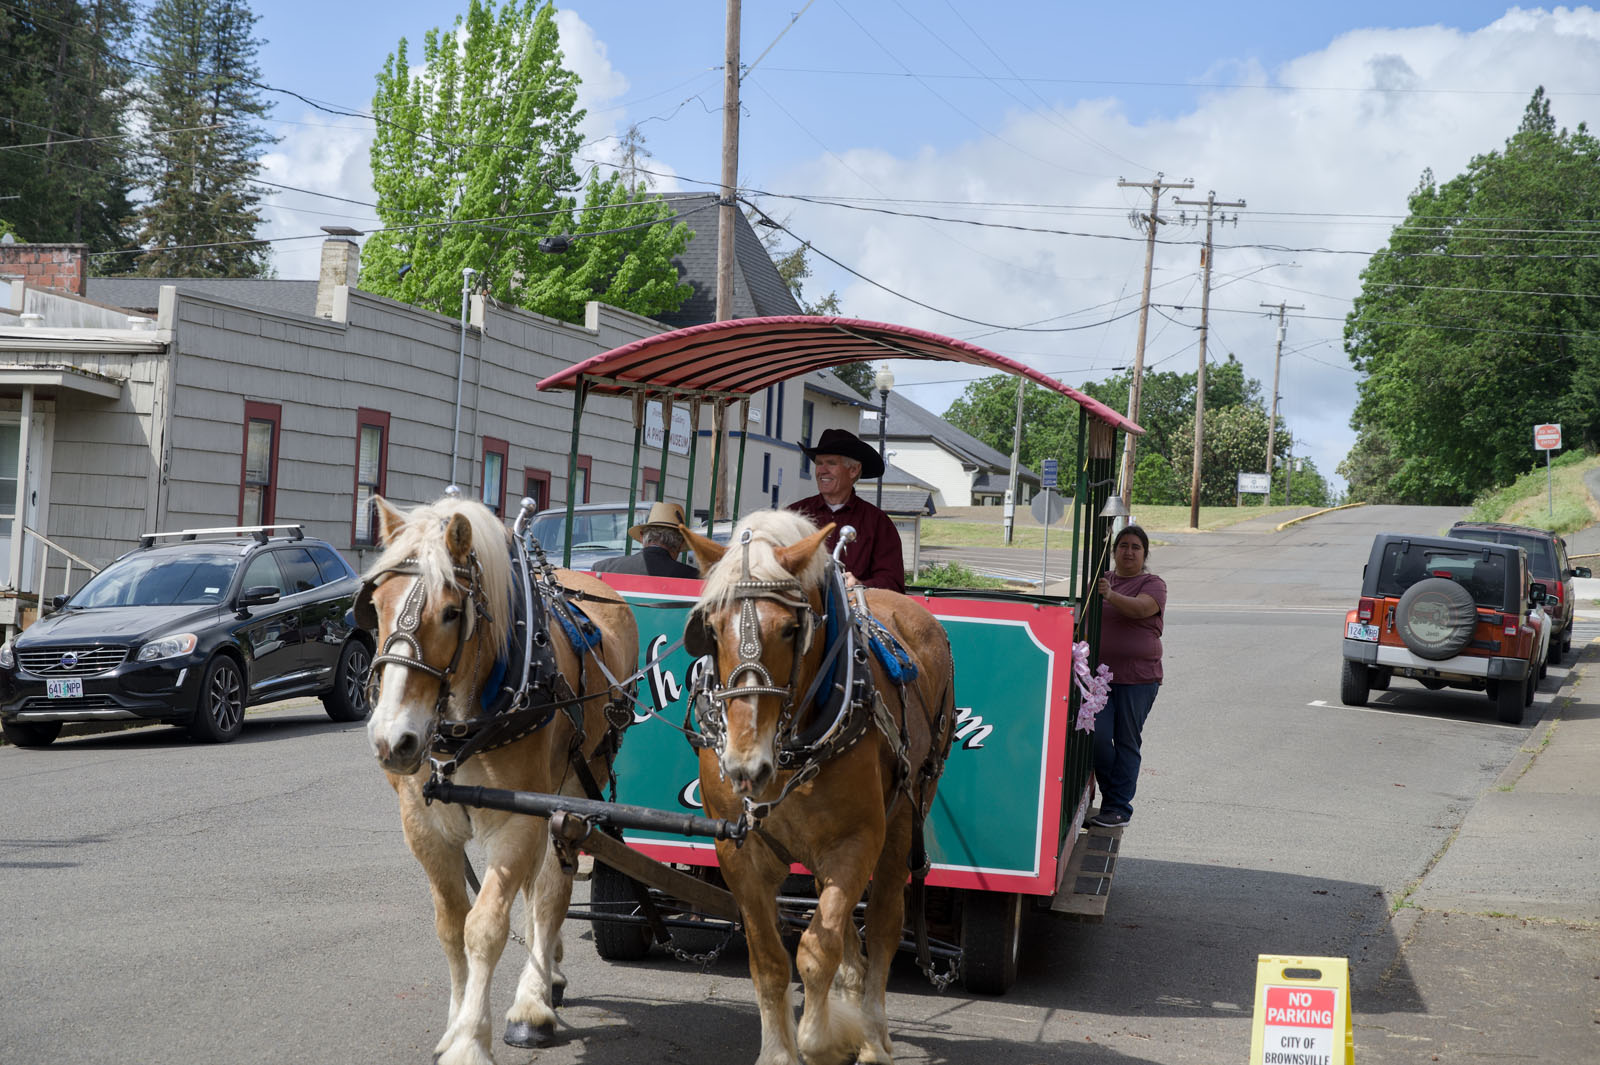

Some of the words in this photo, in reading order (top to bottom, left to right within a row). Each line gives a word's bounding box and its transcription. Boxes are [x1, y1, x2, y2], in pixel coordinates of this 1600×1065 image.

[48, 683, 62, 695] 641
[66, 682, 81, 694] NPP
[1288, 992, 1312, 1007] NO
[1267, 1007, 1332, 1025] PARKING
[1280, 1036, 1301, 1049] CITY
[1303, 1037, 1316, 1049] OF
[1264, 1052, 1330, 1065] BROWNSVILLE
